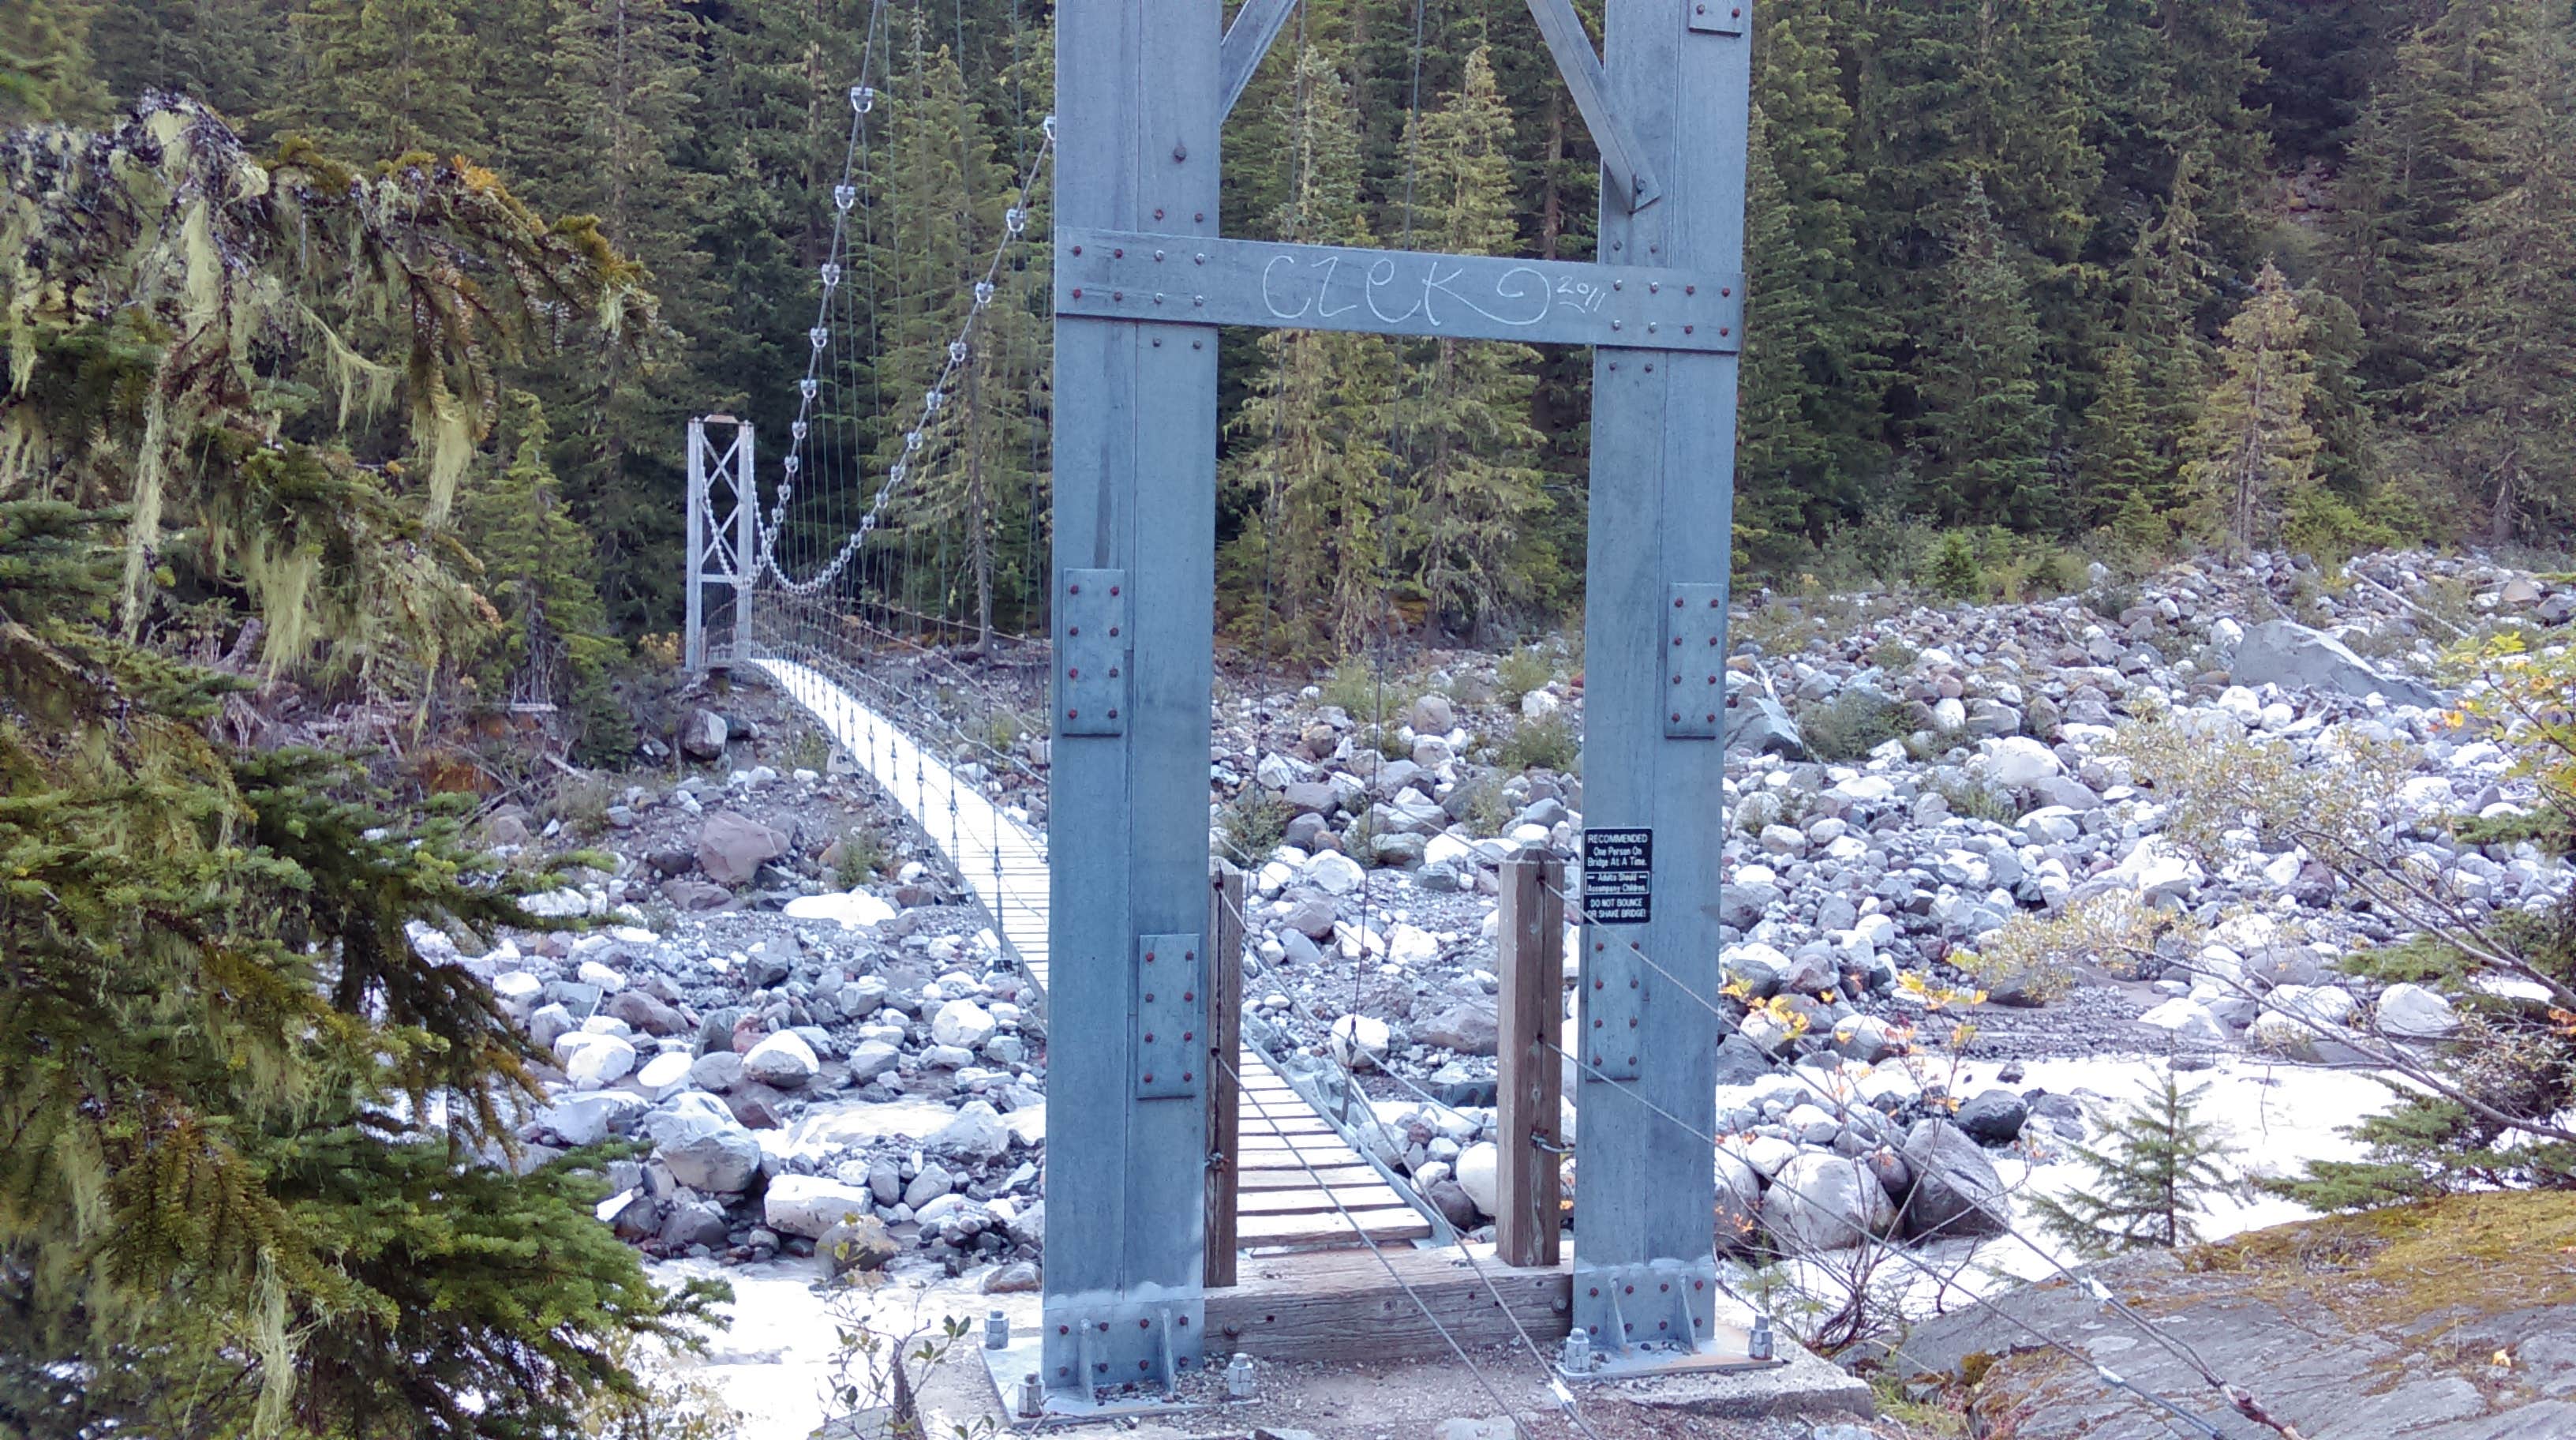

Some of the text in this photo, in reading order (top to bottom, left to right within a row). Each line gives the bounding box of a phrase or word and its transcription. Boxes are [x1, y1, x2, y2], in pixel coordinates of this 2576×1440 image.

[1556, 275, 1606, 314] 2011
[1587, 834, 1648, 844] RECOMMENDED
[1593, 846, 1642, 857] One Person On
[1587, 856, 1647, 868] Bridge At A Time.
[1598, 872, 1637, 882] Adults Should
[1587, 884, 1621, 893] Accompany
[1590, 898, 1642, 908] DO NOT BOUNCE
[1587, 909, 1597, 918] OR
[1598, 909, 1619, 918] SHAKE
